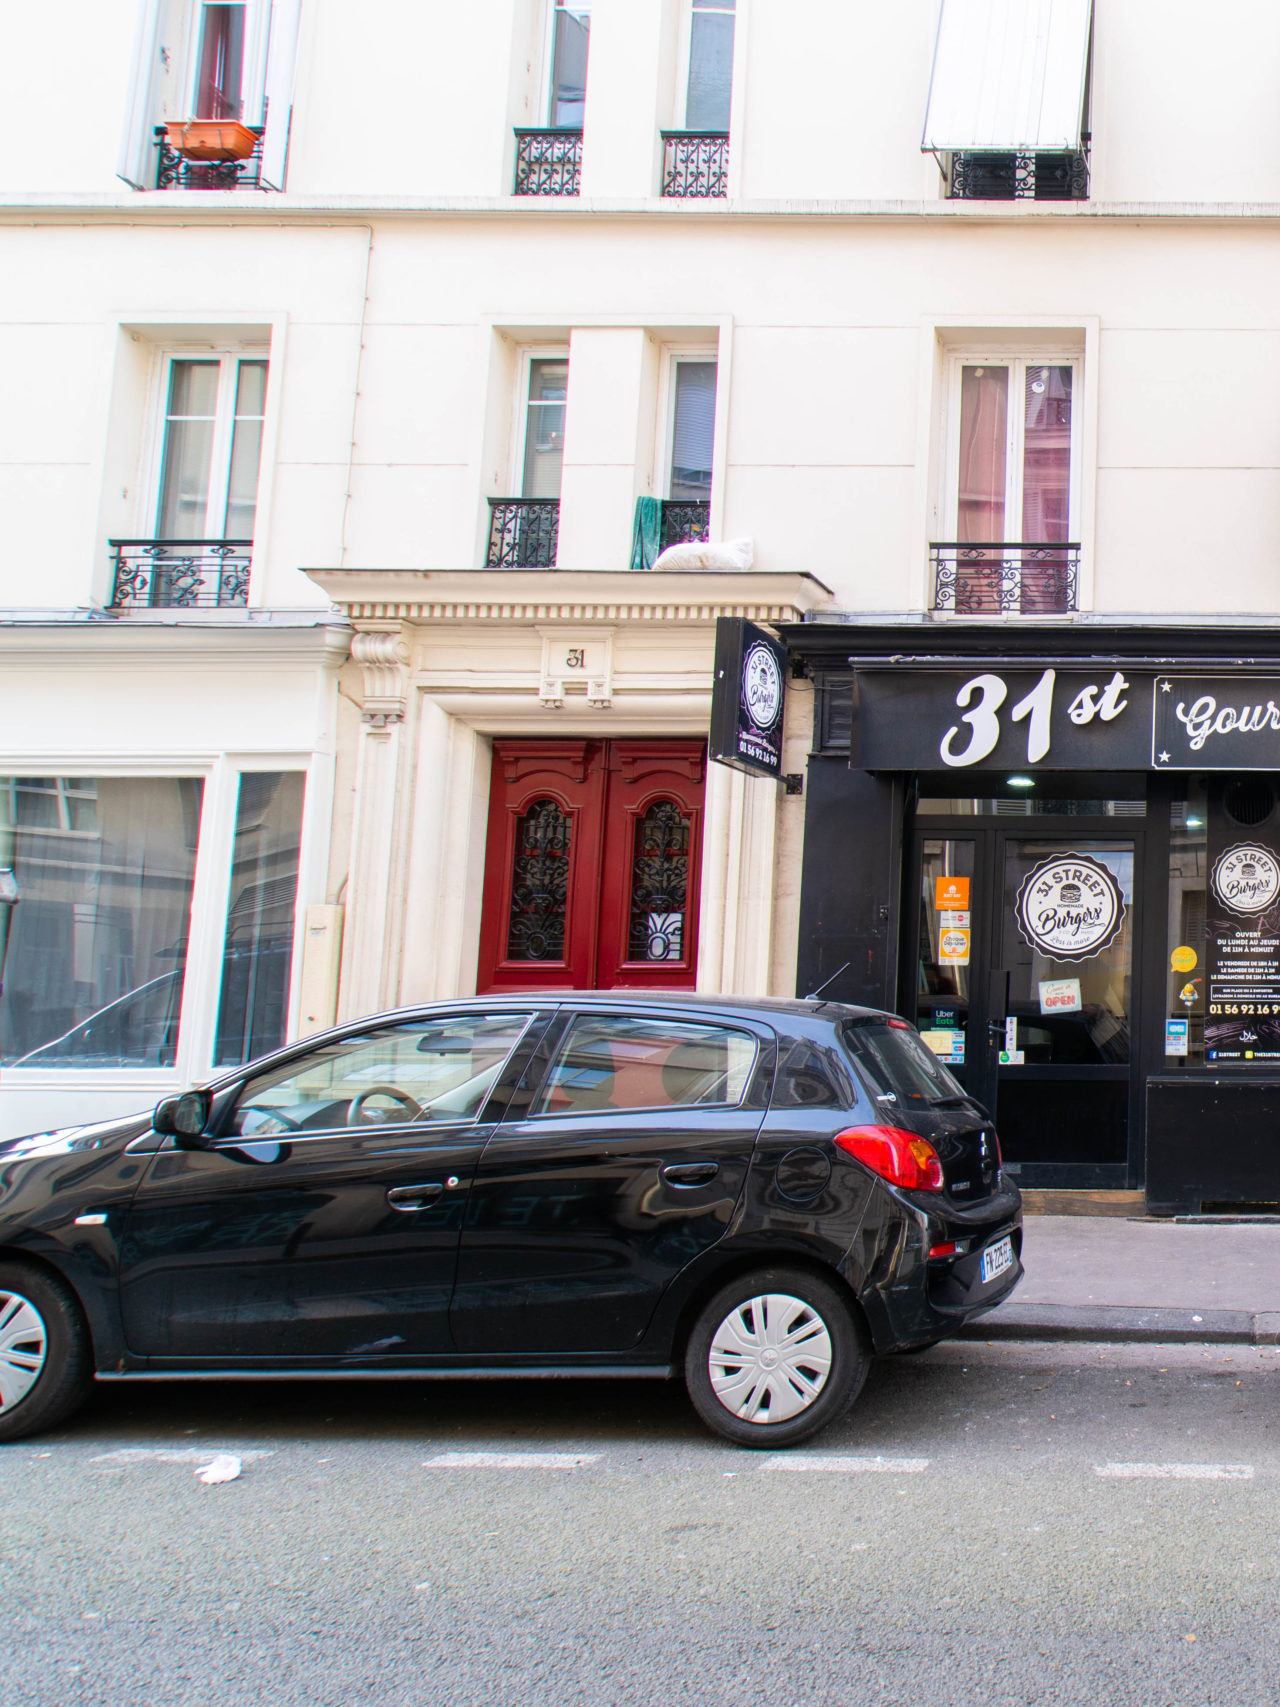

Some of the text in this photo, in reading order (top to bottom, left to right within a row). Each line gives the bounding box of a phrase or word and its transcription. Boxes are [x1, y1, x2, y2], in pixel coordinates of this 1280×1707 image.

[566, 648, 585, 668] 31
[740, 741, 747, 753] 01
[747, 744, 755, 757] 56
[755, 747, 763, 760] 92
[763, 751, 770, 763] 16
[770, 755, 778, 767] 99
[1224, 853, 1273, 874] 31 STREET
[1036, 868, 1106, 898] 31 STREET
[1226, 879, 1271, 900] Burgers
[1035, 907, 1104, 936] Burgers
[1073, 936, 1091, 946] more
[1244, 945, 1249, 953] À
[1044, 995, 1075, 1007] OPEN
[1209, 1004, 1222, 1014] 01
[1224, 1004, 1239, 1014] 56
[1241, 1004, 1255, 1014] 92
[1256, 1004, 1270, 1014] 16
[935, 1010, 954, 1018] Uber
